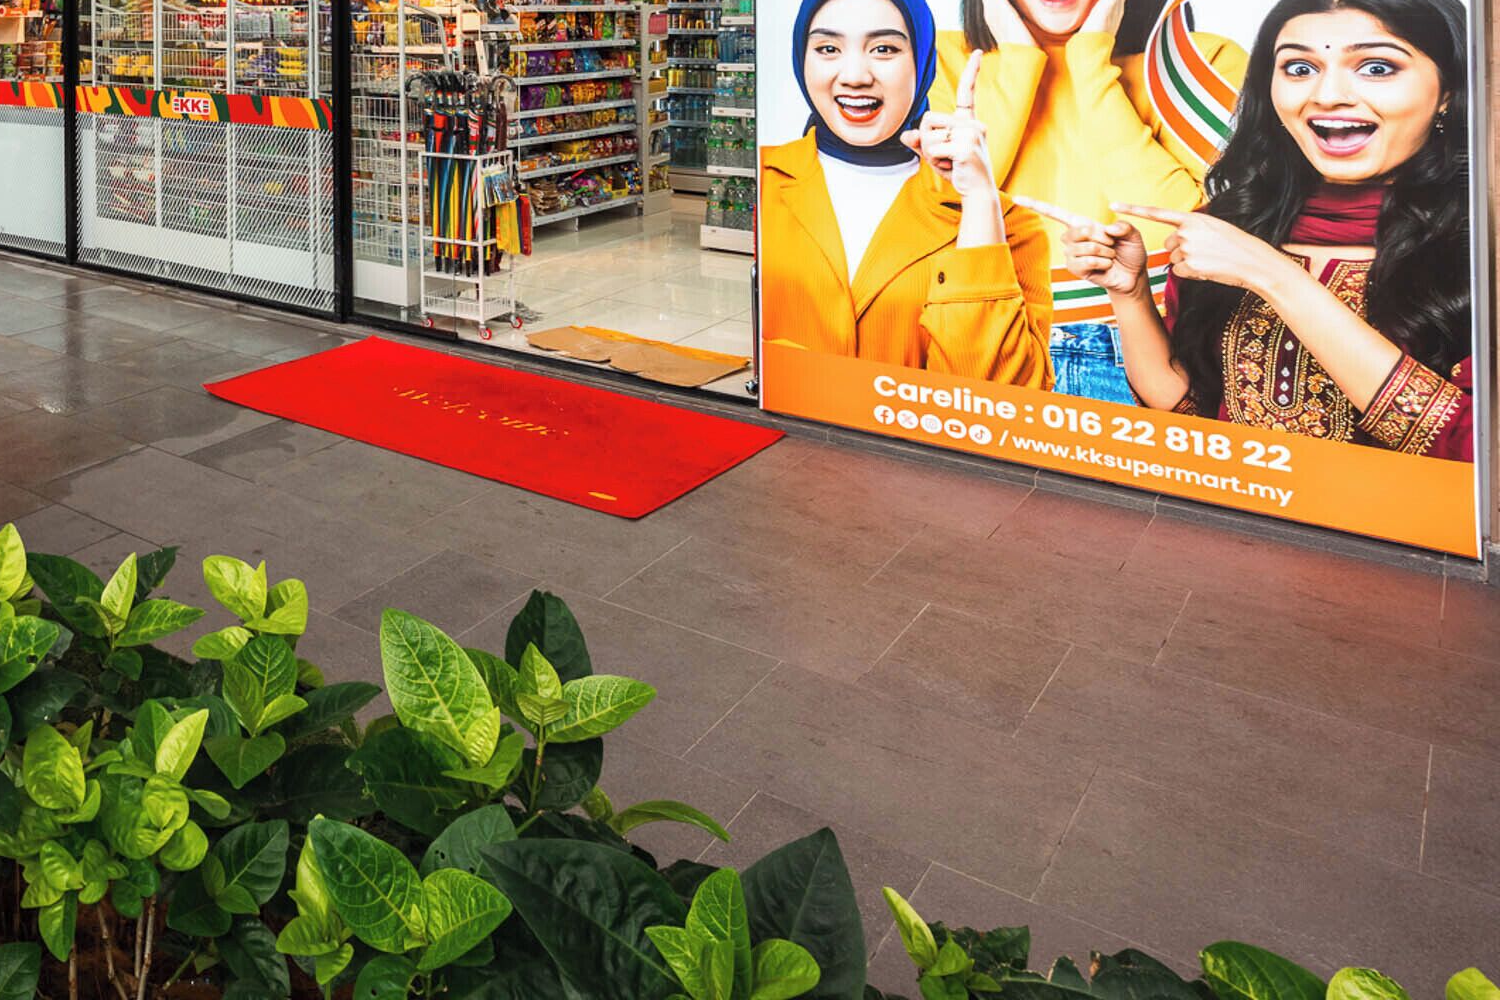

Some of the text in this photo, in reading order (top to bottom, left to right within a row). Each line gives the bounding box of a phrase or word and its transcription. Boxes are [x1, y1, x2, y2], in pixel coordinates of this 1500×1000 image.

[180, 98, 202, 113] KK
[873, 375, 1017, 421] Careline
[1041, 403, 1102, 437] 016
[1110, 416, 1157, 447] 22
[1164, 424, 1232, 462] 818
[1242, 440, 1293, 473] 22
[1011, 435, 1294, 508] www.kksupermart.my
